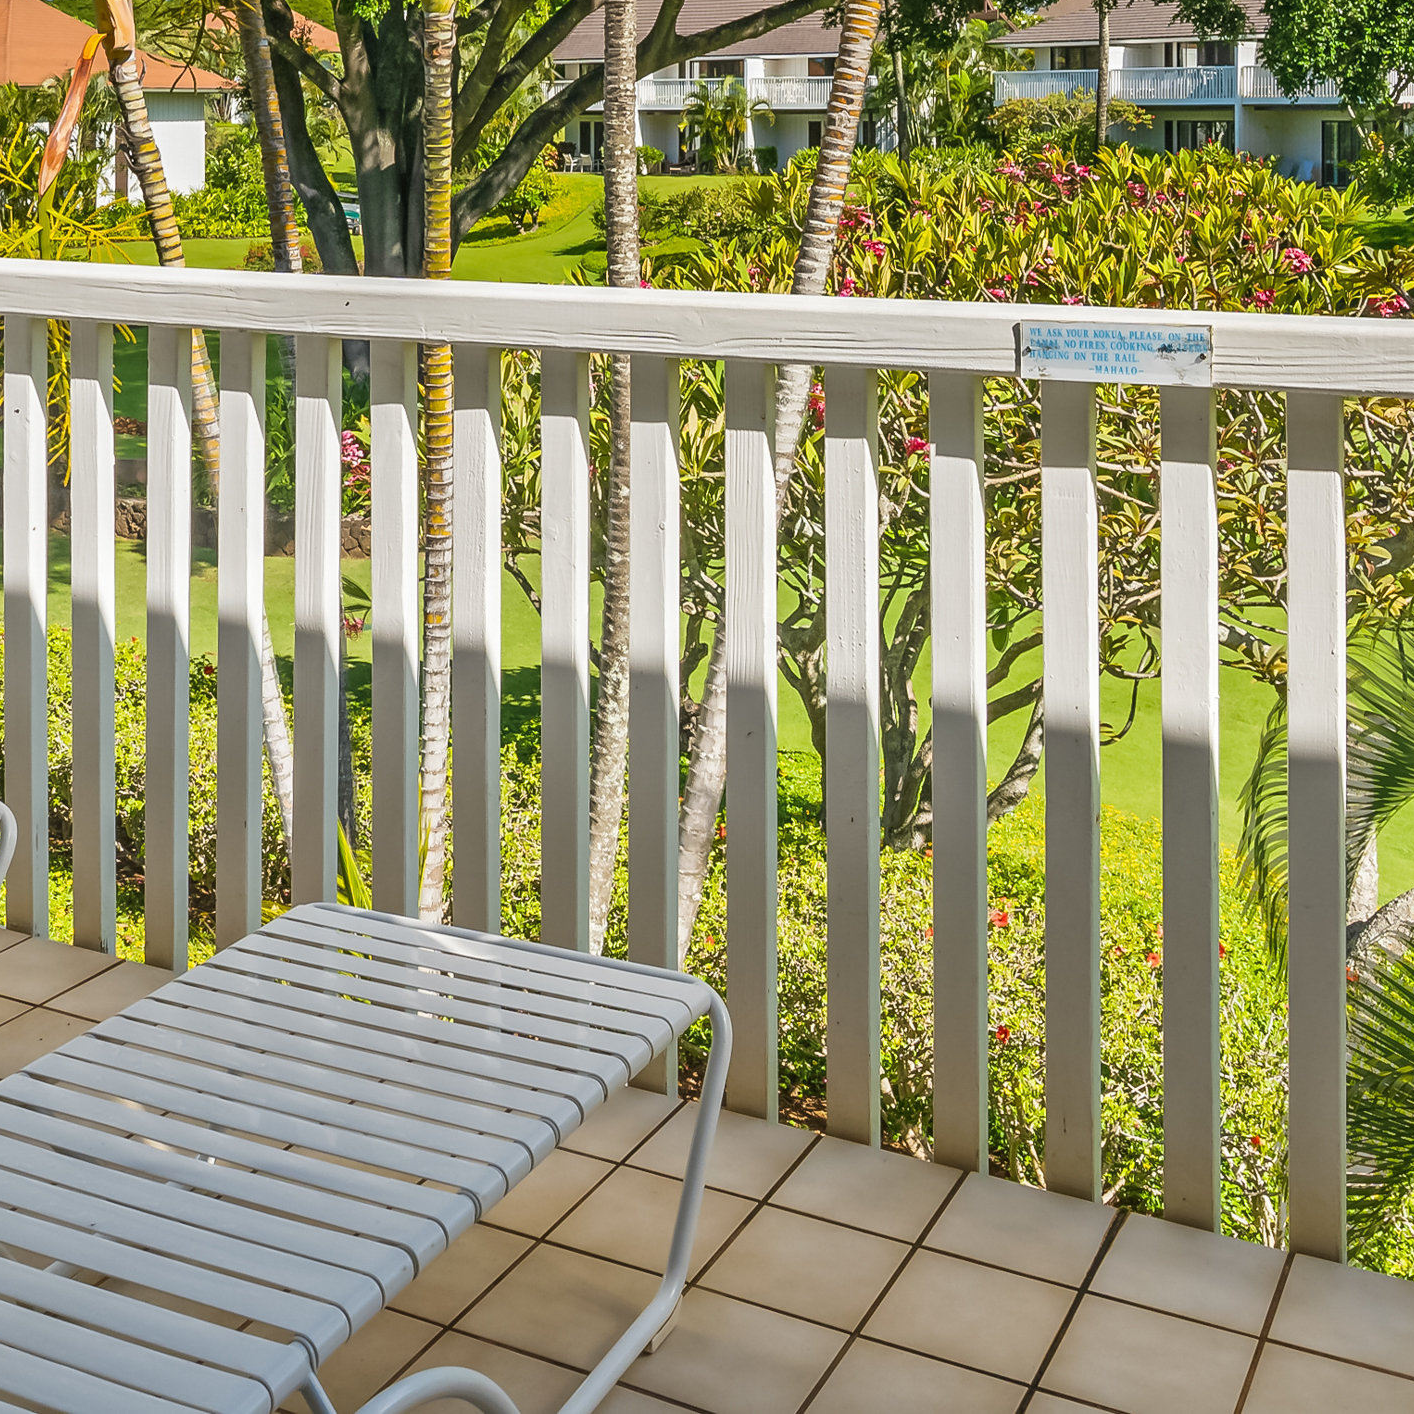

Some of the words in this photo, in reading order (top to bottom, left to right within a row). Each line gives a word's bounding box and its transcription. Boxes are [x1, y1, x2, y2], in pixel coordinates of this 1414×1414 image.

[1029, 327, 1042, 336] WE
[1046, 328, 1063, 337] ASK
[1066, 328, 1089, 338] YOUR
[1168, 332, 1181, 341] ON
[1186, 333, 1205, 342] THE
[1064, 339, 1076, 348] NO
[1079, 340, 1108, 351] FIRES,
[1029, 349, 1069, 359] HANGING
[1074, 352, 1086, 360] ON
[1091, 352, 1109, 361] THE
[1115, 353, 1140, 362] RAIL.
